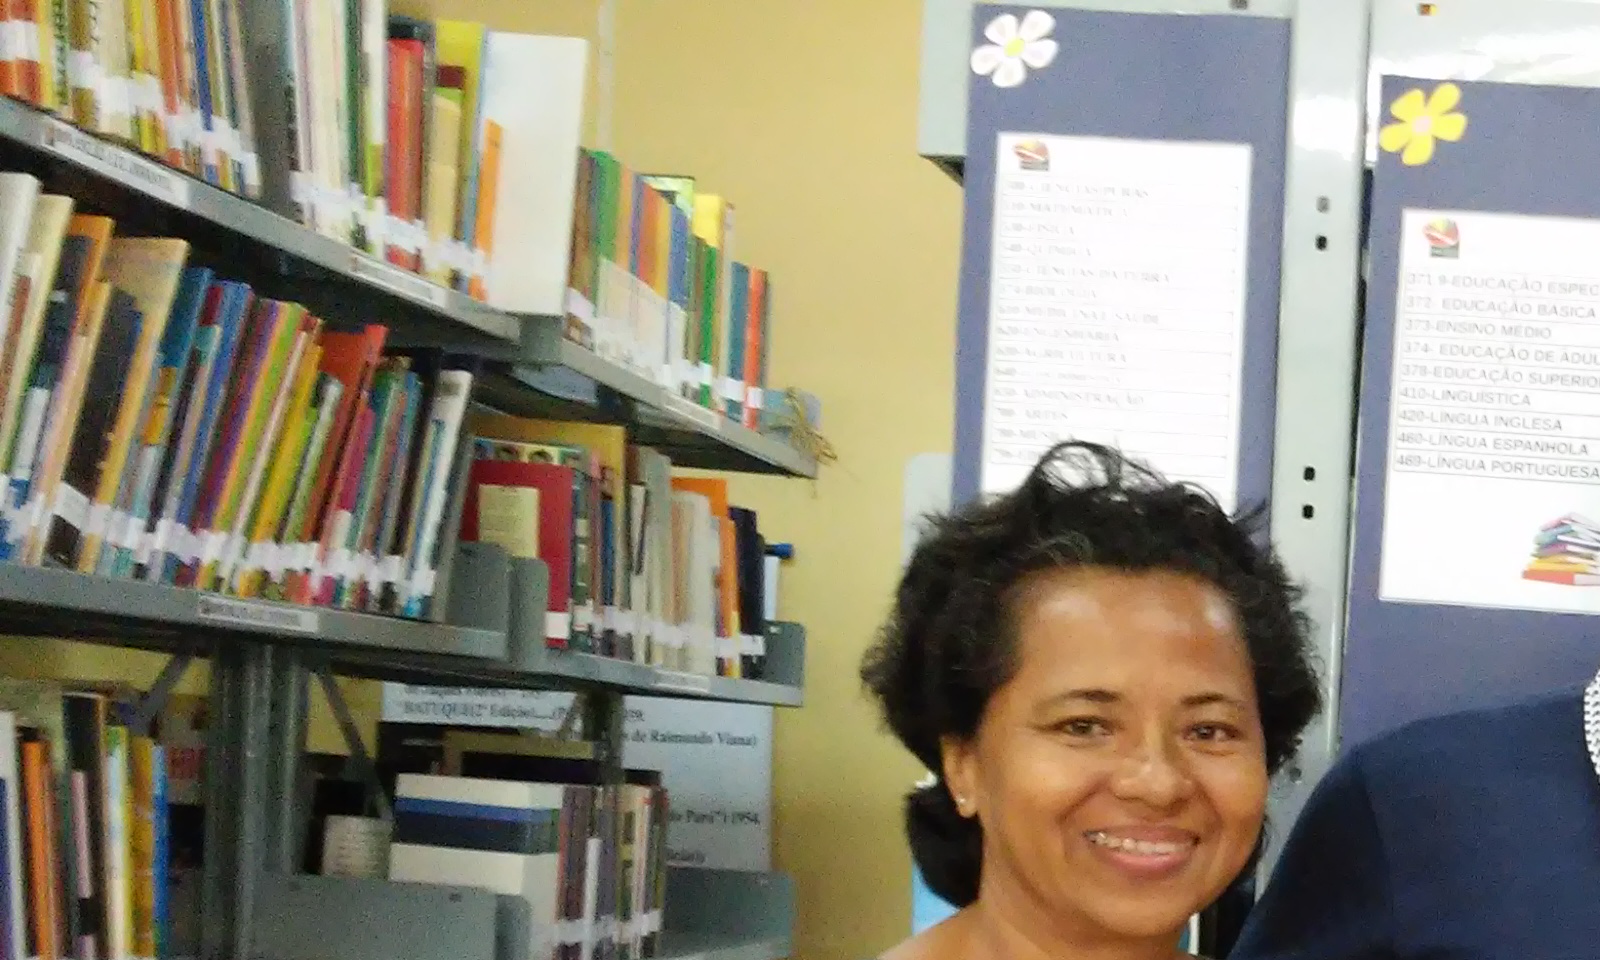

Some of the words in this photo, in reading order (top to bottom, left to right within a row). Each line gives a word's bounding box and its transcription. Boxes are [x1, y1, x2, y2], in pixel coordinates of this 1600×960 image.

[1534, 348, 1555, 362] DE
[1493, 416, 1563, 432] INGLESA
[1492, 438, 1589, 456] ESPANHOLA
[1490, 460, 1600, 479] PORTUGUESA
